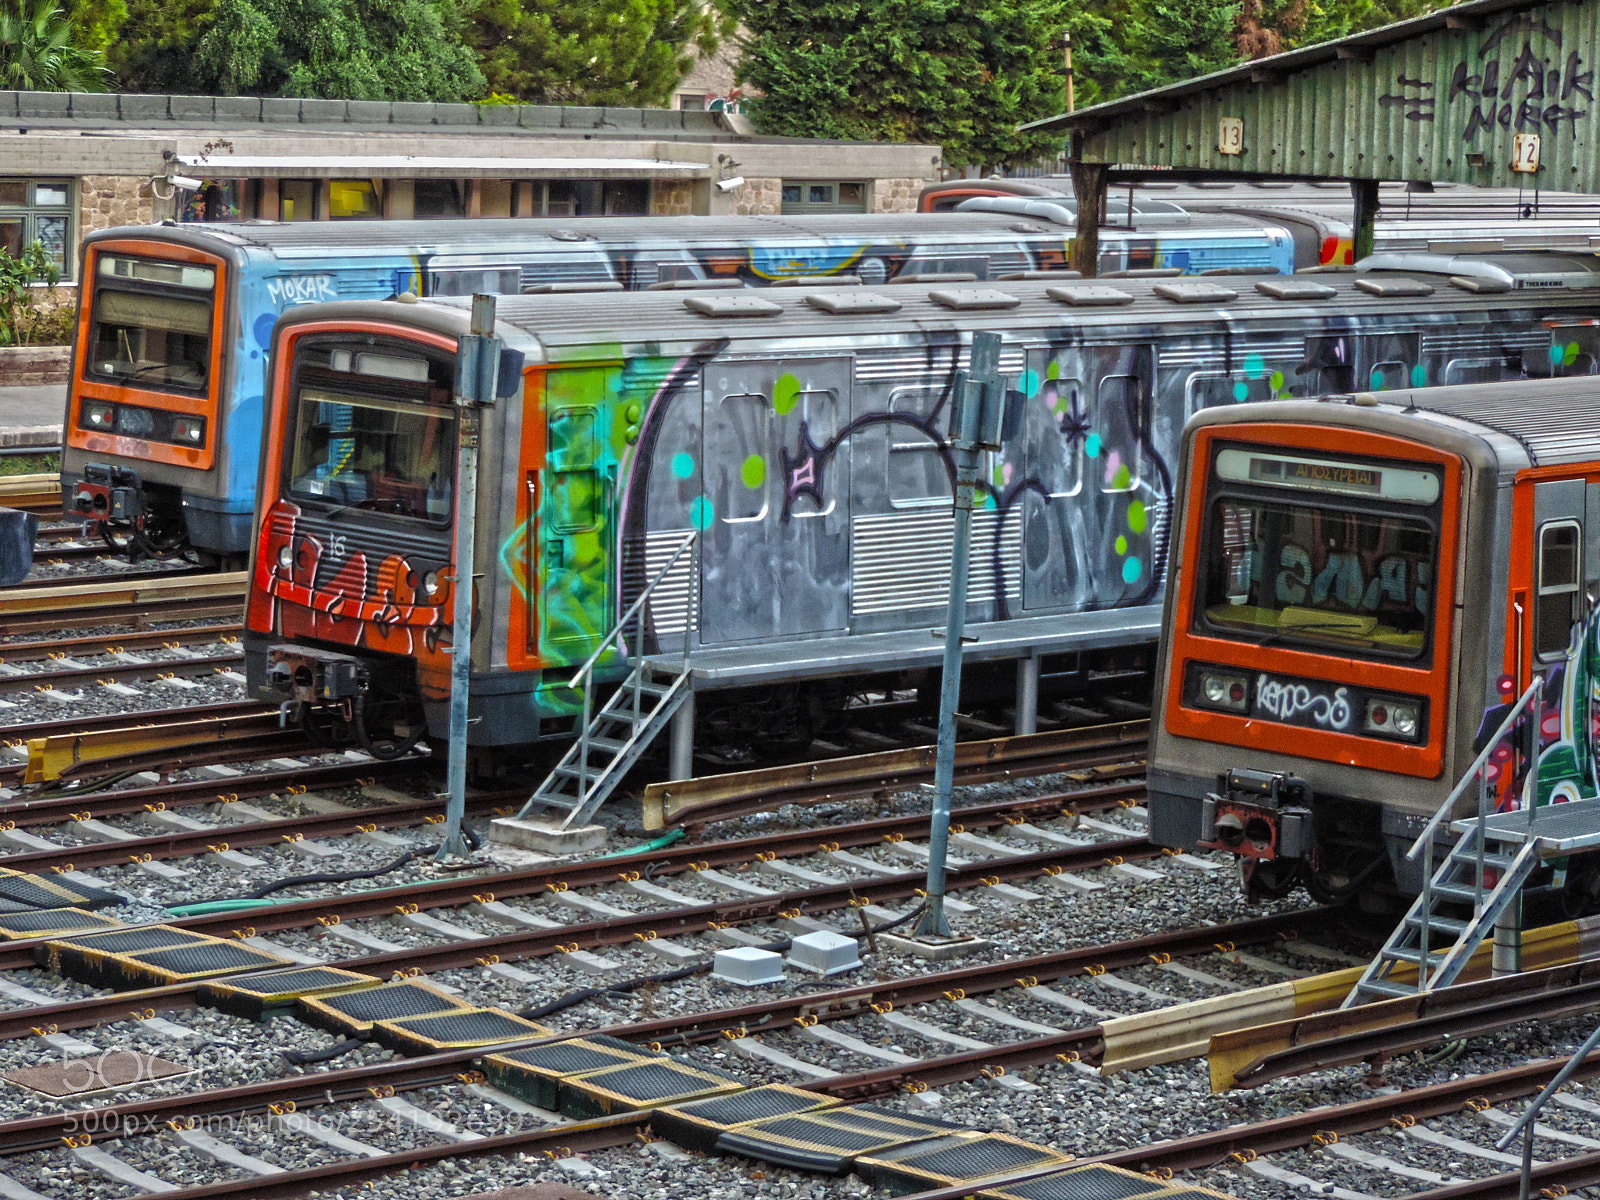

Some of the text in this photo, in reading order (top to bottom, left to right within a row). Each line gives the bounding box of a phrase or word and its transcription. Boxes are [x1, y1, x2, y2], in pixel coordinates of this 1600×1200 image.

[1223, 126, 1240, 146] 13
[1517, 142, 1535, 163] 12
[267, 274, 337, 304] MOKAR
